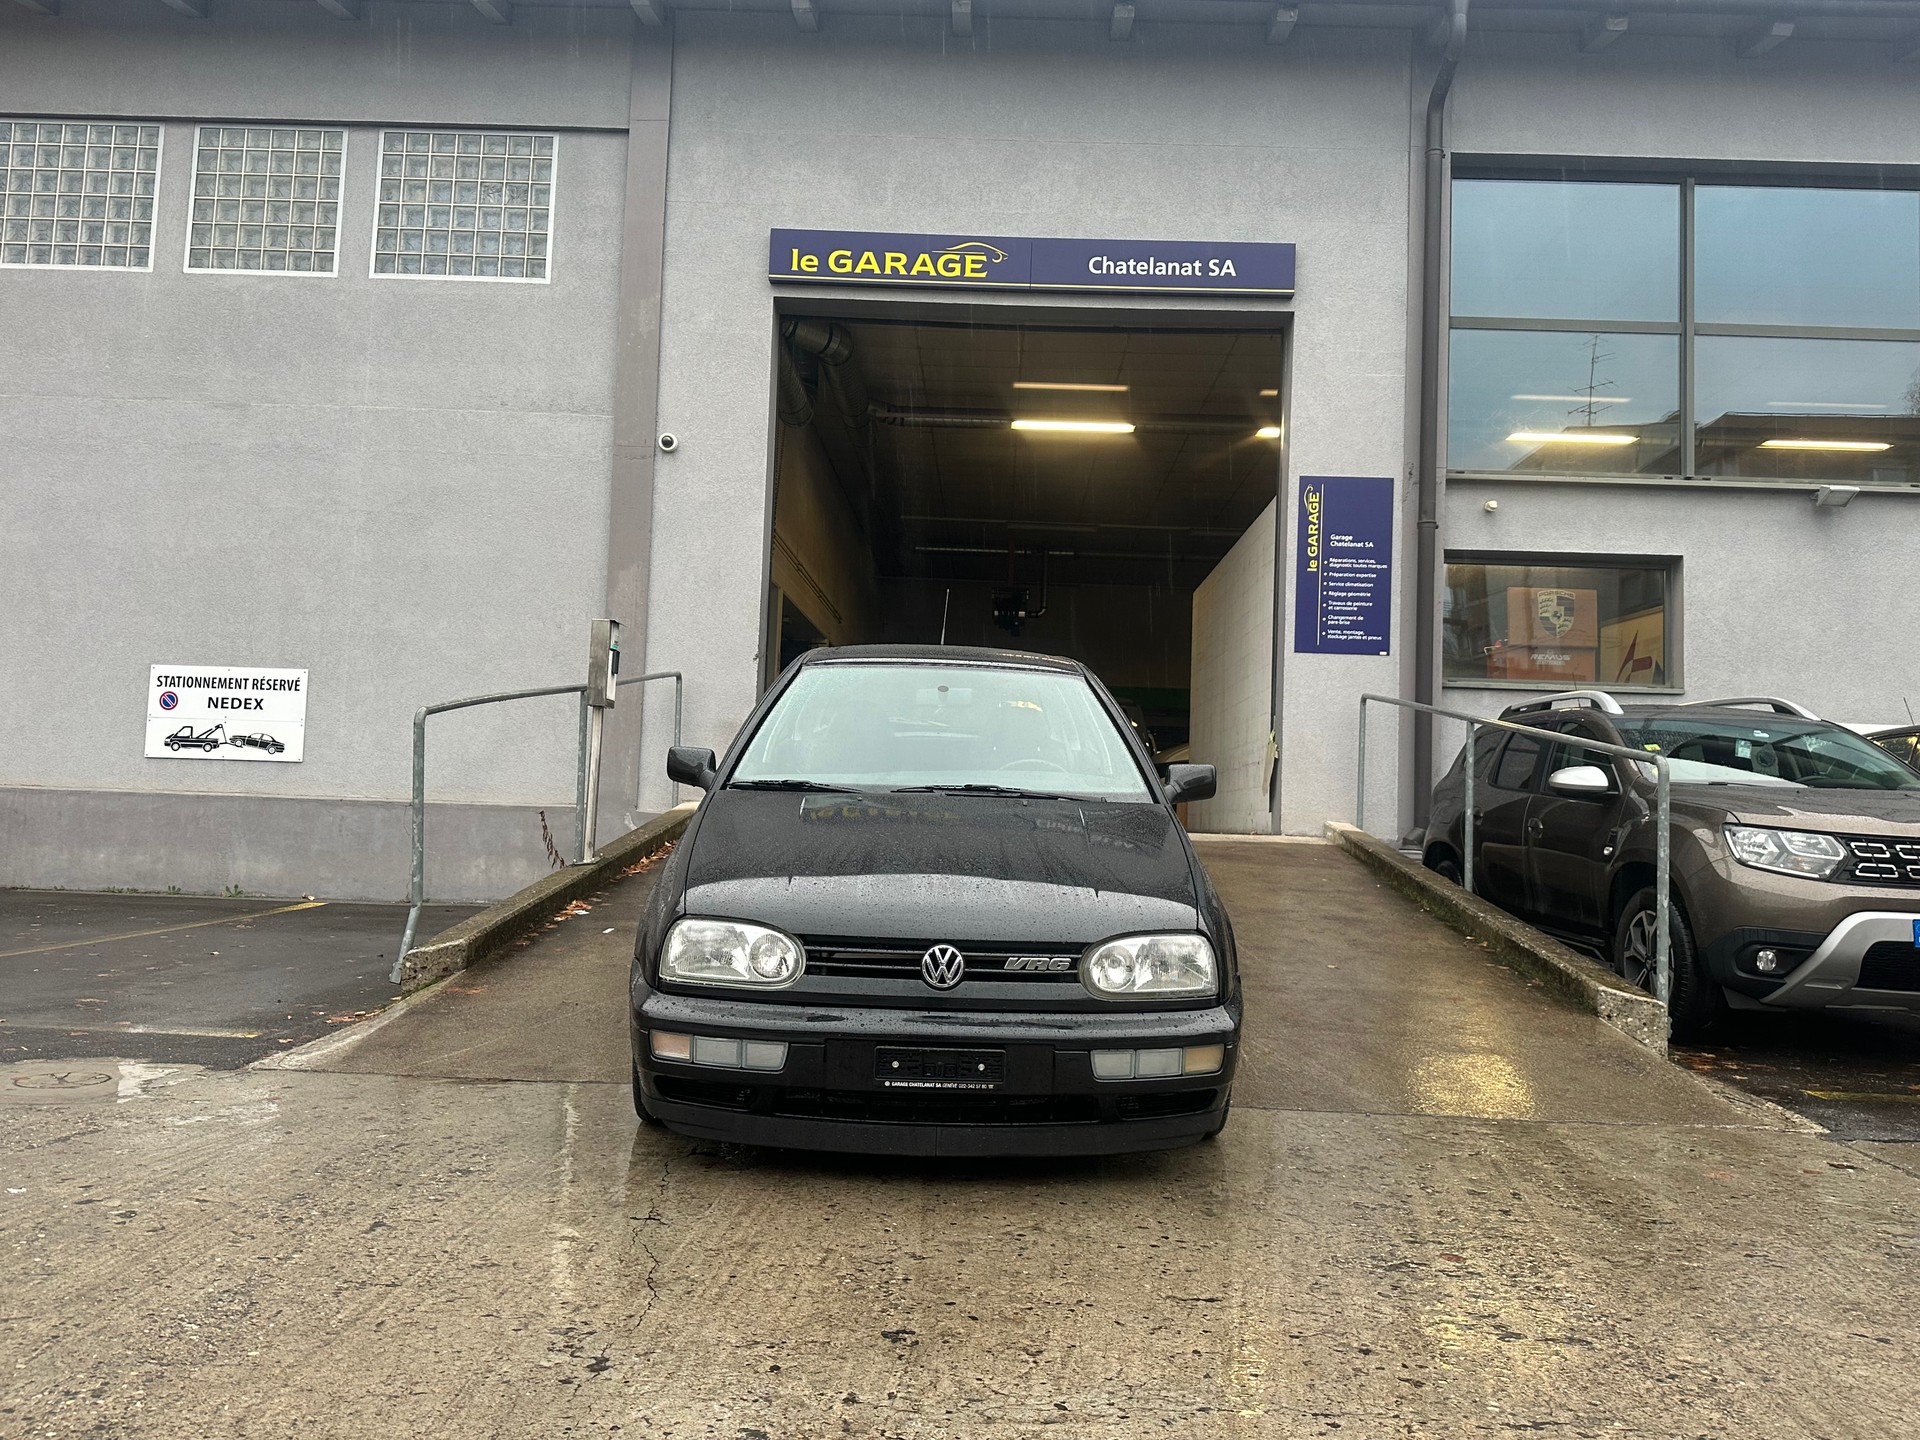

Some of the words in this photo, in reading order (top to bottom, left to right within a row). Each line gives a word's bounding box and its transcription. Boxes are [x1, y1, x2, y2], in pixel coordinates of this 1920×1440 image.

[790, 248, 819, 272] le
[827, 250, 988, 278] GARAGE
[1088, 255, 1202, 276] Chatelanat
[1208, 258, 1237, 277] SA
[1307, 492, 1320, 557] GARAGE
[1330, 540, 1364, 548] Chatelanat
[1307, 560, 1318, 571] le
[1530, 653, 1571, 661] REMUS
[157, 675, 249, 690] STATIONNEMENT
[252, 676, 301, 692] RÉSERVÉ
[207, 697, 264, 710] NEDEX
[1004, 957, 1072, 971] VR6
